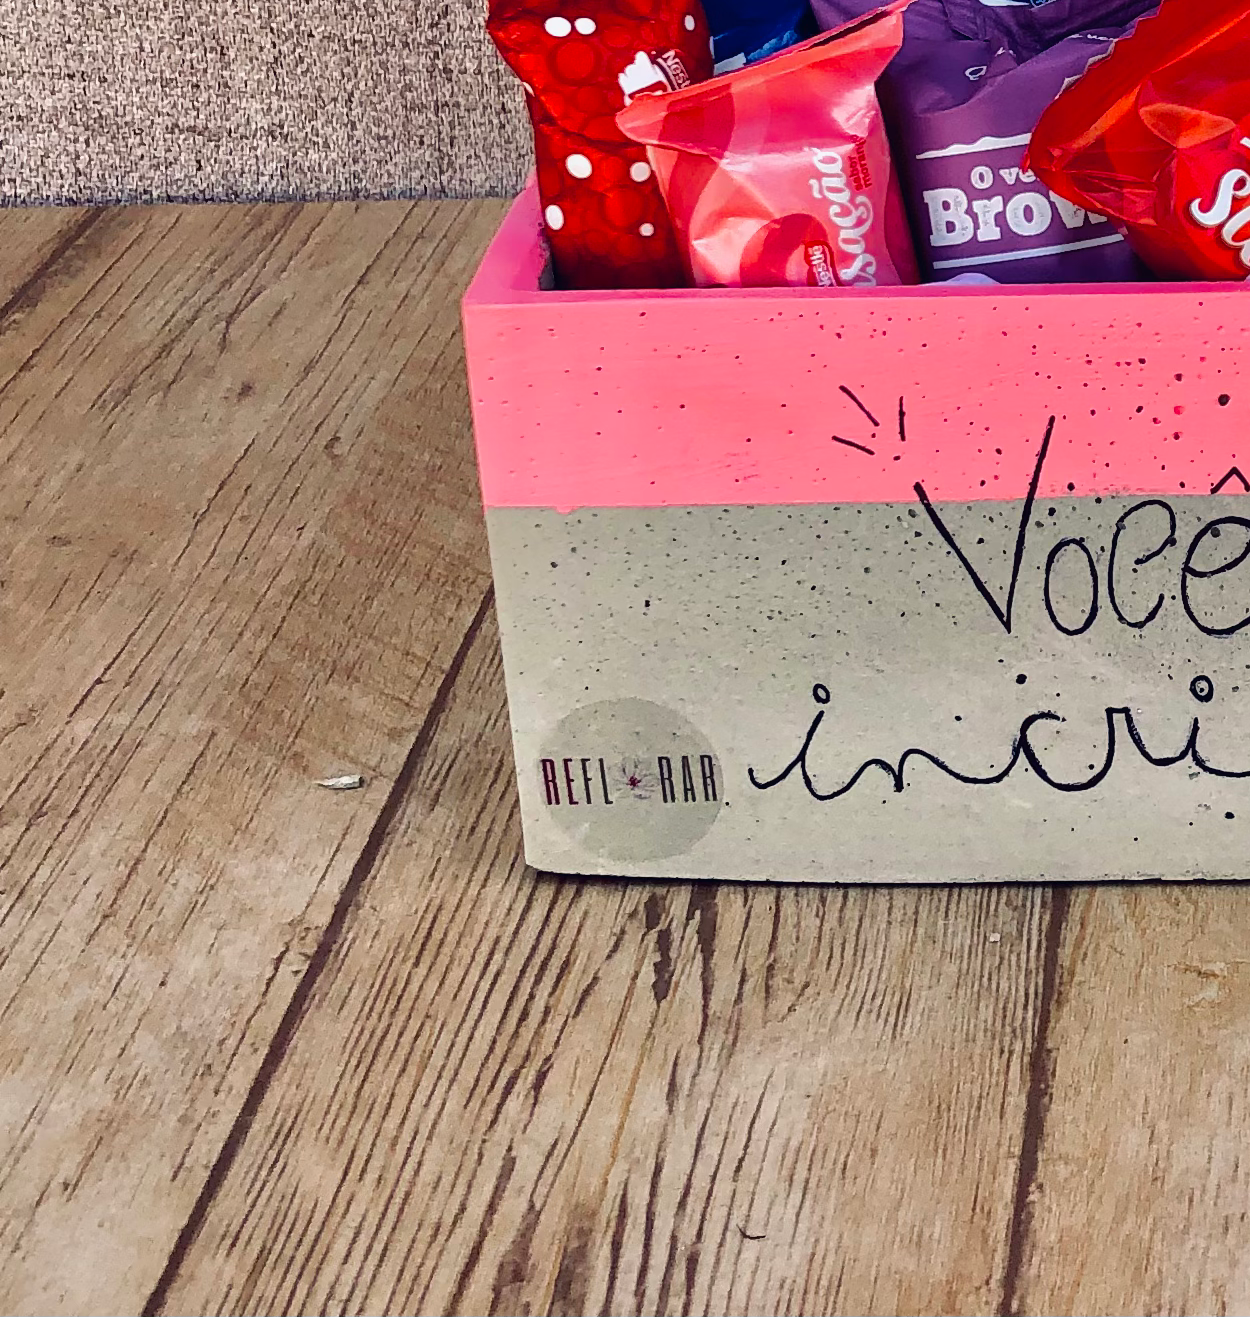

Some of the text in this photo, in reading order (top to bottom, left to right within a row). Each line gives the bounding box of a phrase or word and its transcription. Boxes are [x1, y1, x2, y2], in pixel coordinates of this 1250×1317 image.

[970, 165, 1038, 190] O ve
[539, 753, 719, 806] REFLRAR
